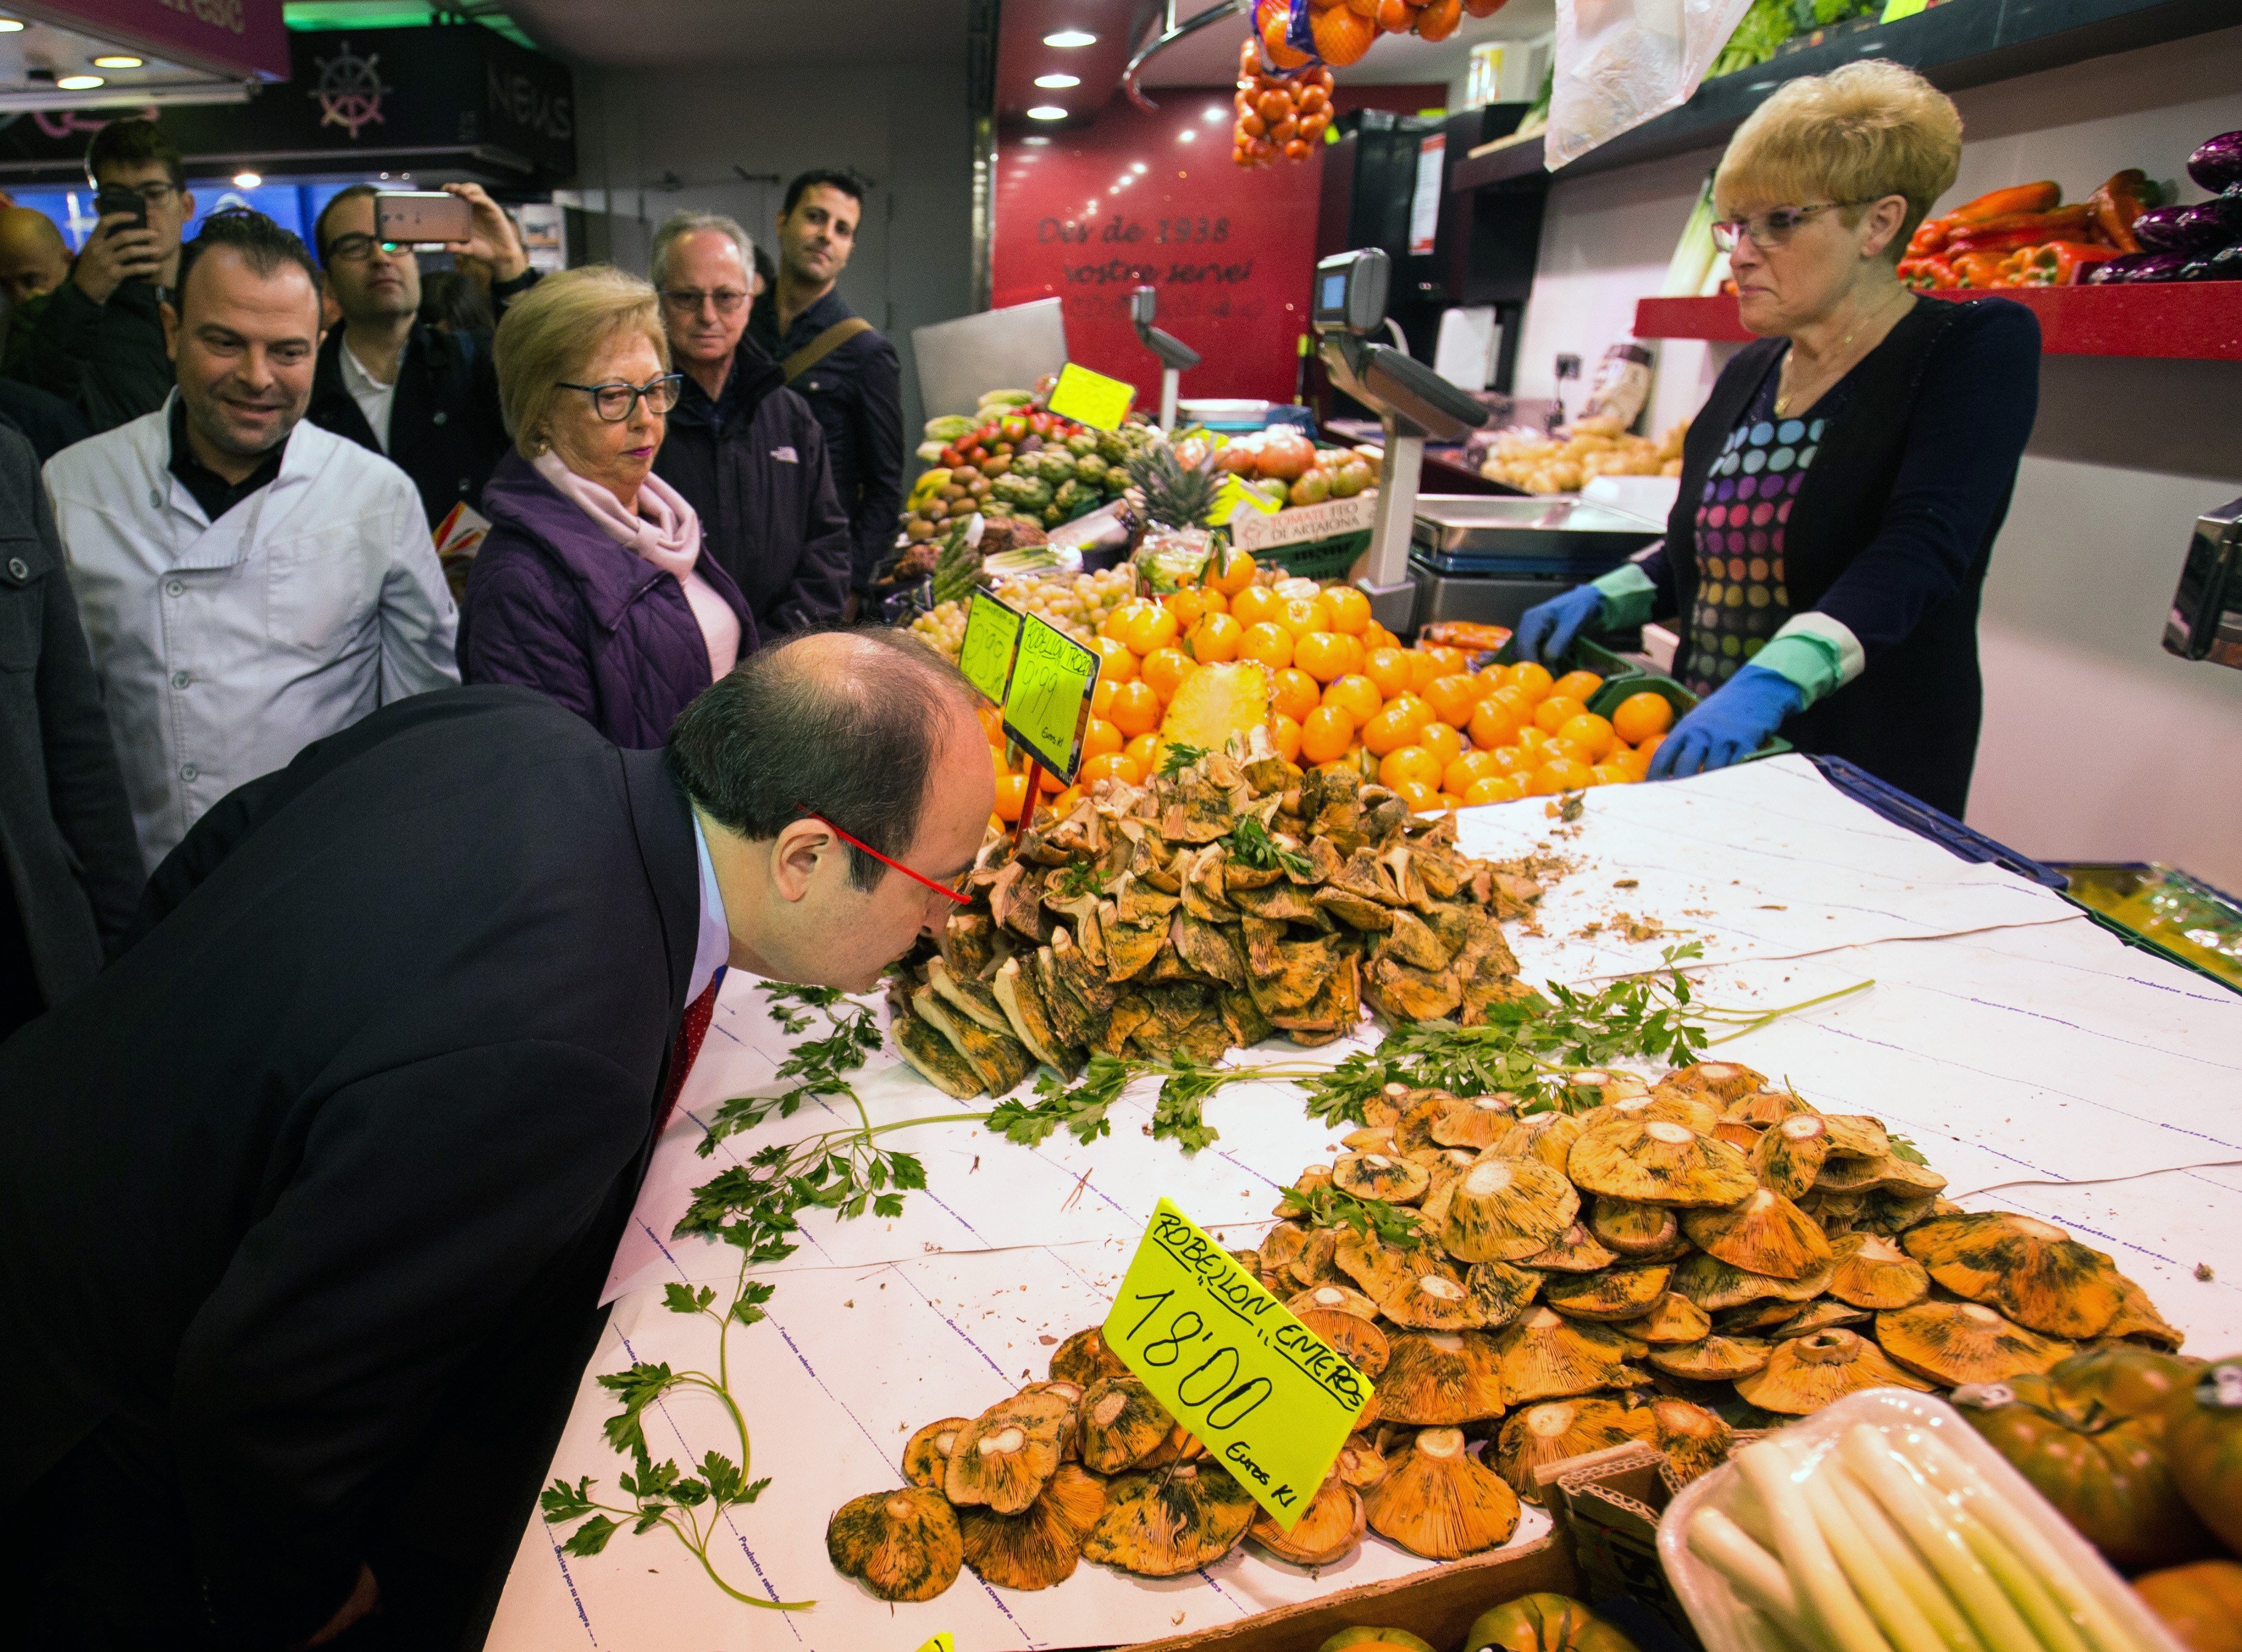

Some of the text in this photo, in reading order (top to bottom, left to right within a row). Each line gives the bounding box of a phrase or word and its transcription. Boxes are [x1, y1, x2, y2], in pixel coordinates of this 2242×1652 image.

[2052, 1215, 2177, 1264] Productos selectos
[1152, 1213, 1365, 1407] ROBELLON ENTEROS
[1127, 1289, 1273, 1430] 18'00
[1225, 1441, 1270, 1487] Euros
[738, 1535, 764, 1577] Productos
